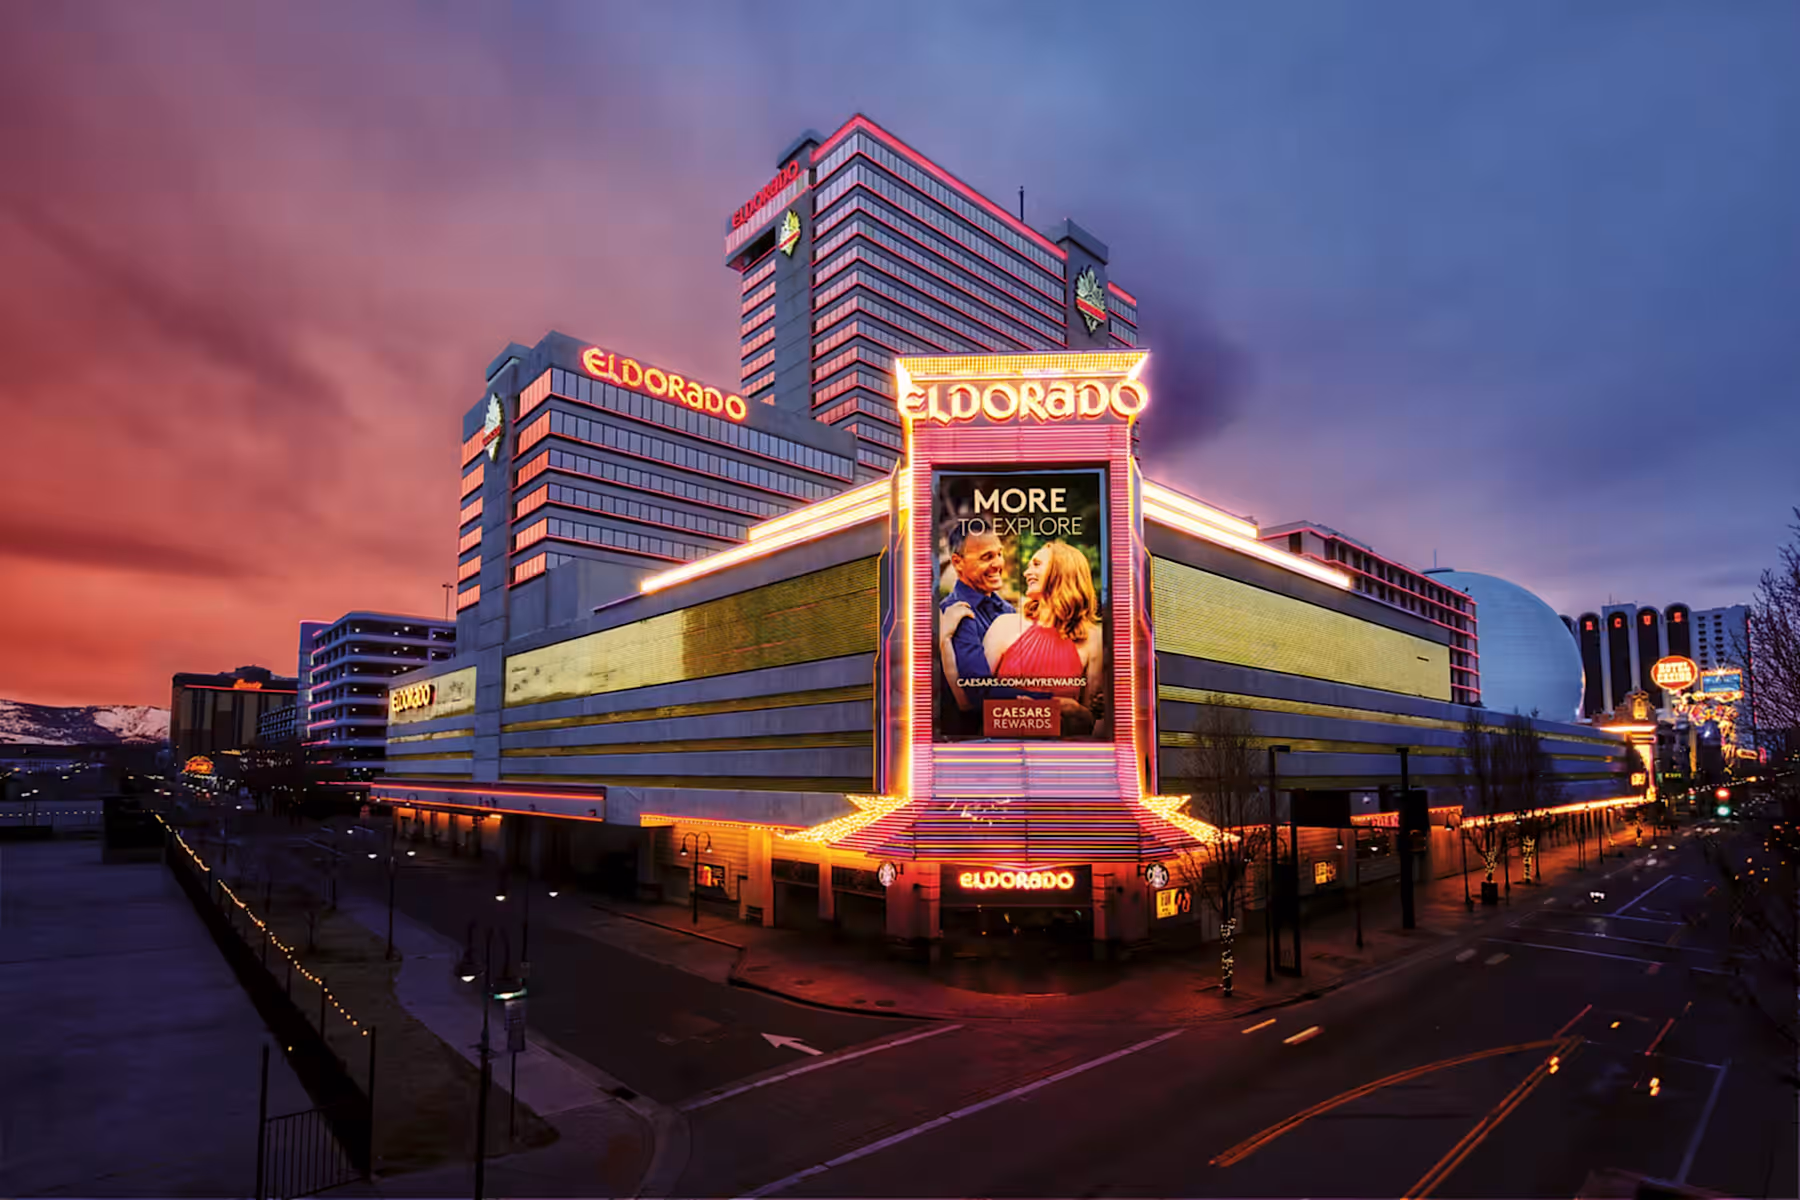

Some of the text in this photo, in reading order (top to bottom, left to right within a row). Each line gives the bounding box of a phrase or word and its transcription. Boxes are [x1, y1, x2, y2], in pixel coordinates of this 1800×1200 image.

[974, 488, 1067, 513] MORE
[958, 517, 1083, 536] TO EXPLORE
[957, 678, 1087, 688] CAESARS.COM/MYREWARDS
[992, 707, 1051, 718] CAESARS
[993, 719, 1052, 729] REWARDS
